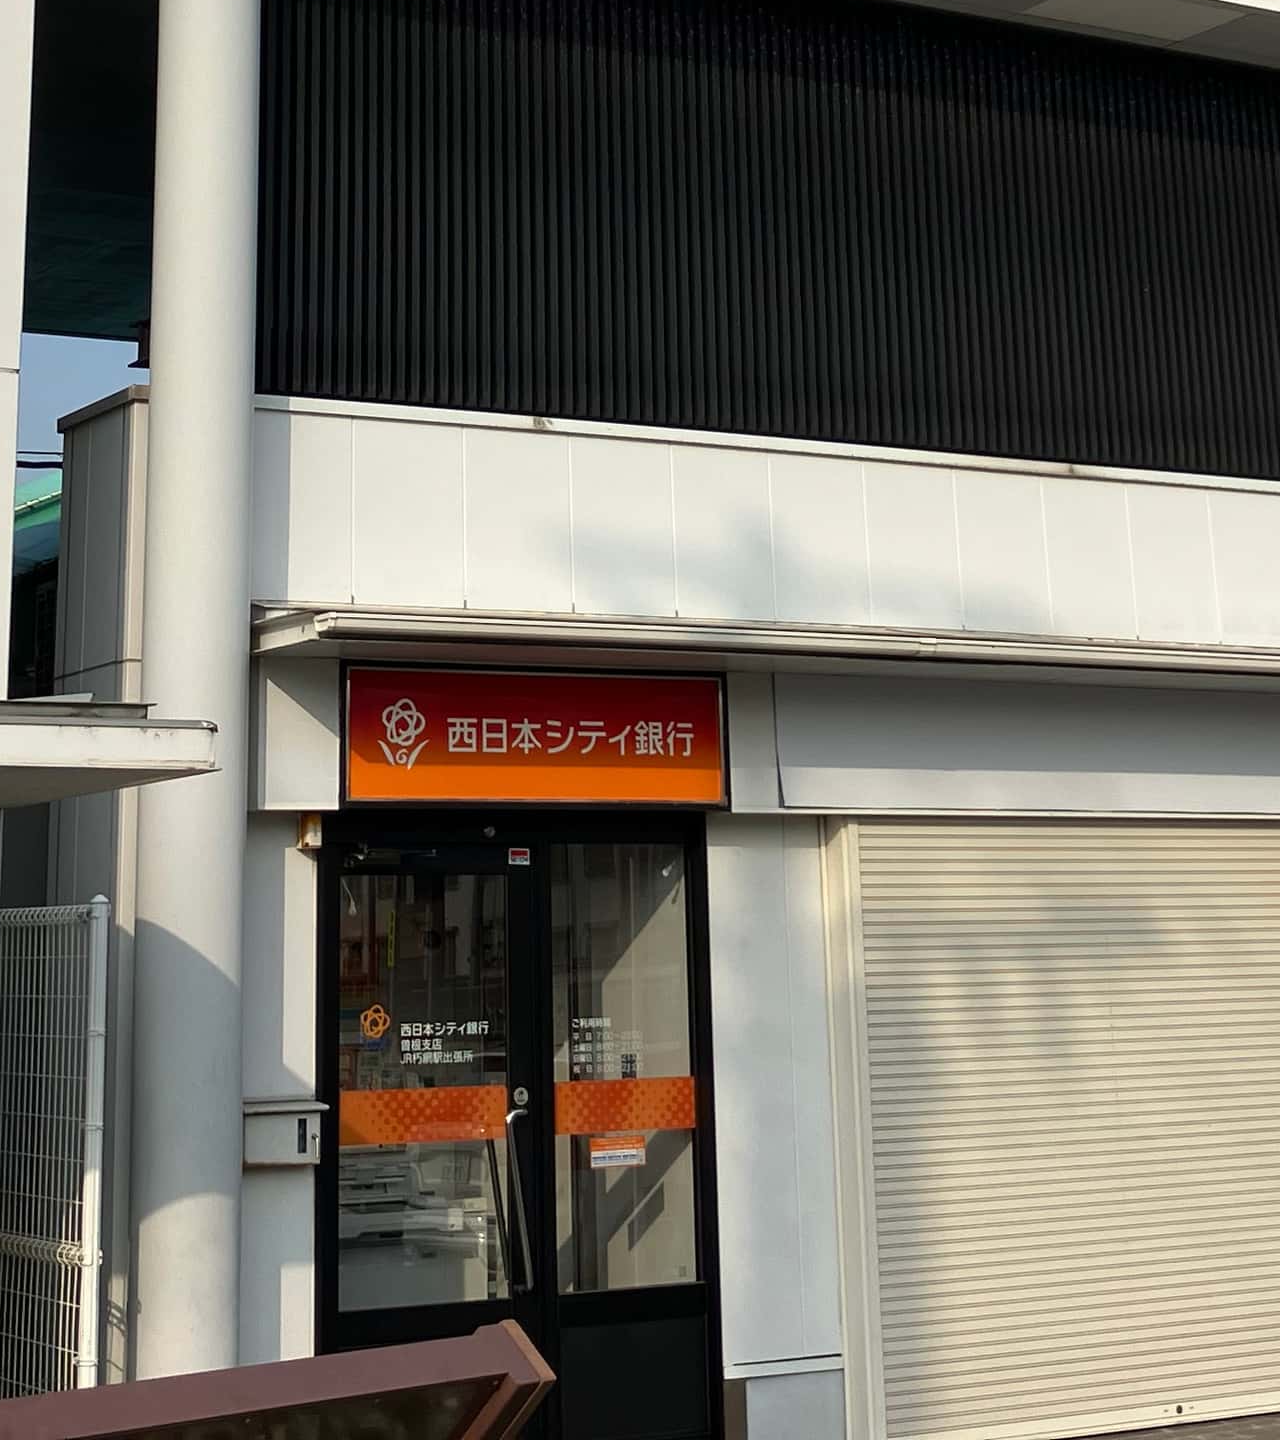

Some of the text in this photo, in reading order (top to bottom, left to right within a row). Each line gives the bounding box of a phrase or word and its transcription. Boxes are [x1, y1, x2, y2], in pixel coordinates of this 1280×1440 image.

[447, 718, 694, 757] 西日本シティ銀行
[401, 1021, 489, 1037] 西日本シティ銀行
